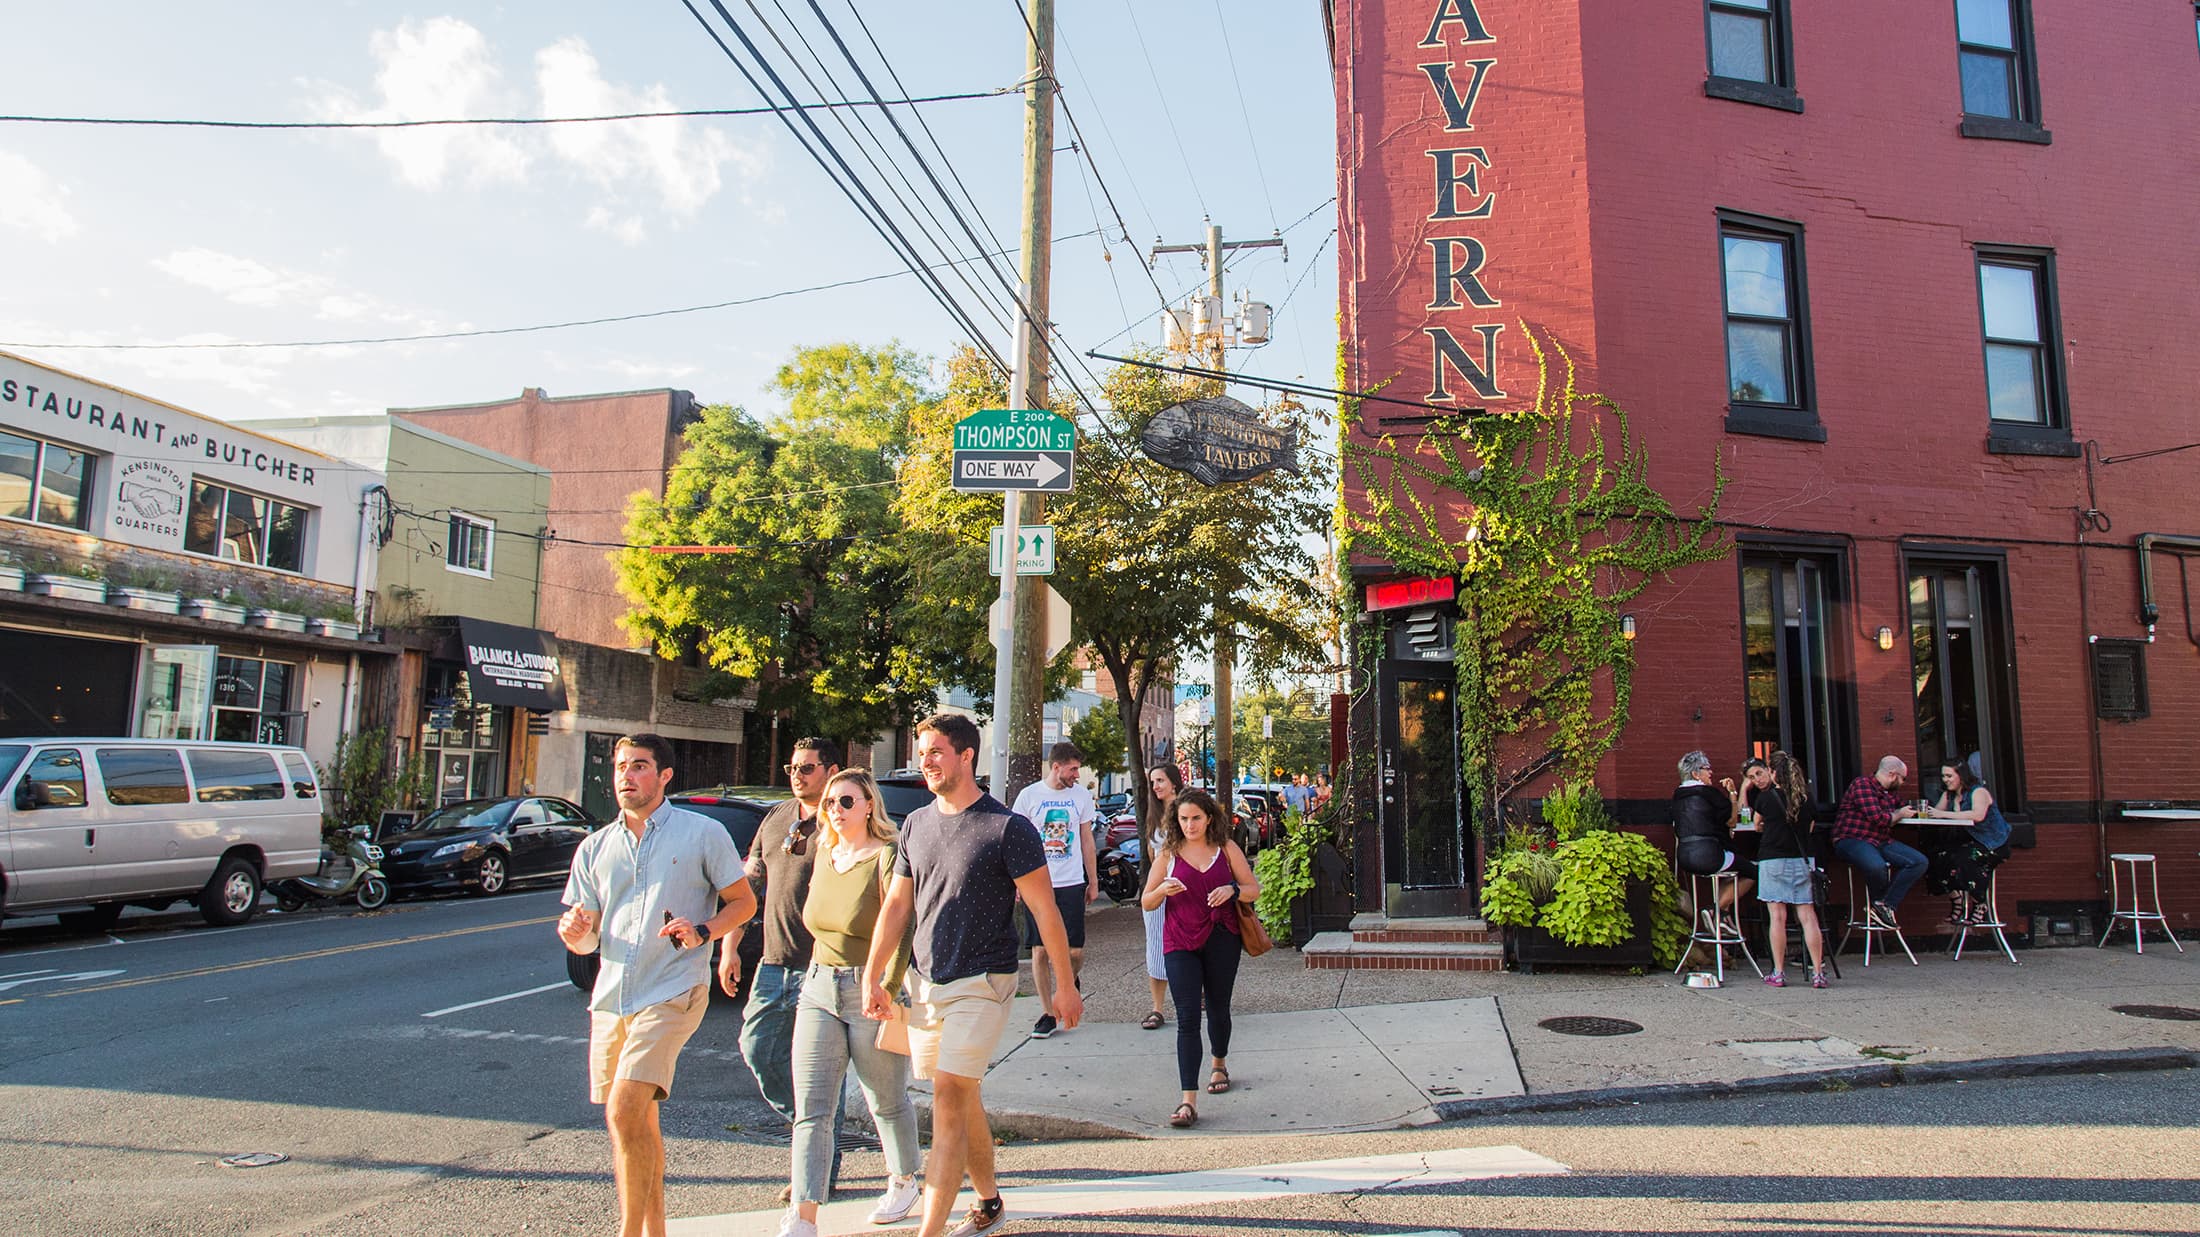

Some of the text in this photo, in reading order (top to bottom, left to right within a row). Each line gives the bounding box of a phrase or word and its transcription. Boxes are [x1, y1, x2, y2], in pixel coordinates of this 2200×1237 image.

[1417, 0, 1507, 402] AVERN
[1010, 411, 1045, 423] E 200
[2, 379, 315, 486] STAURANT AND BUTCHER
[958, 425, 1071, 449] THOMPSON ST
[965, 462, 1035, 477] ONE WAY
[1202, 443, 1272, 470] TAVERN
[121, 461, 185, 490] KENSINGTON
[116, 516, 178, 537] QUARTERS
[468, 645, 560, 676] BALANCE STUDIOS
